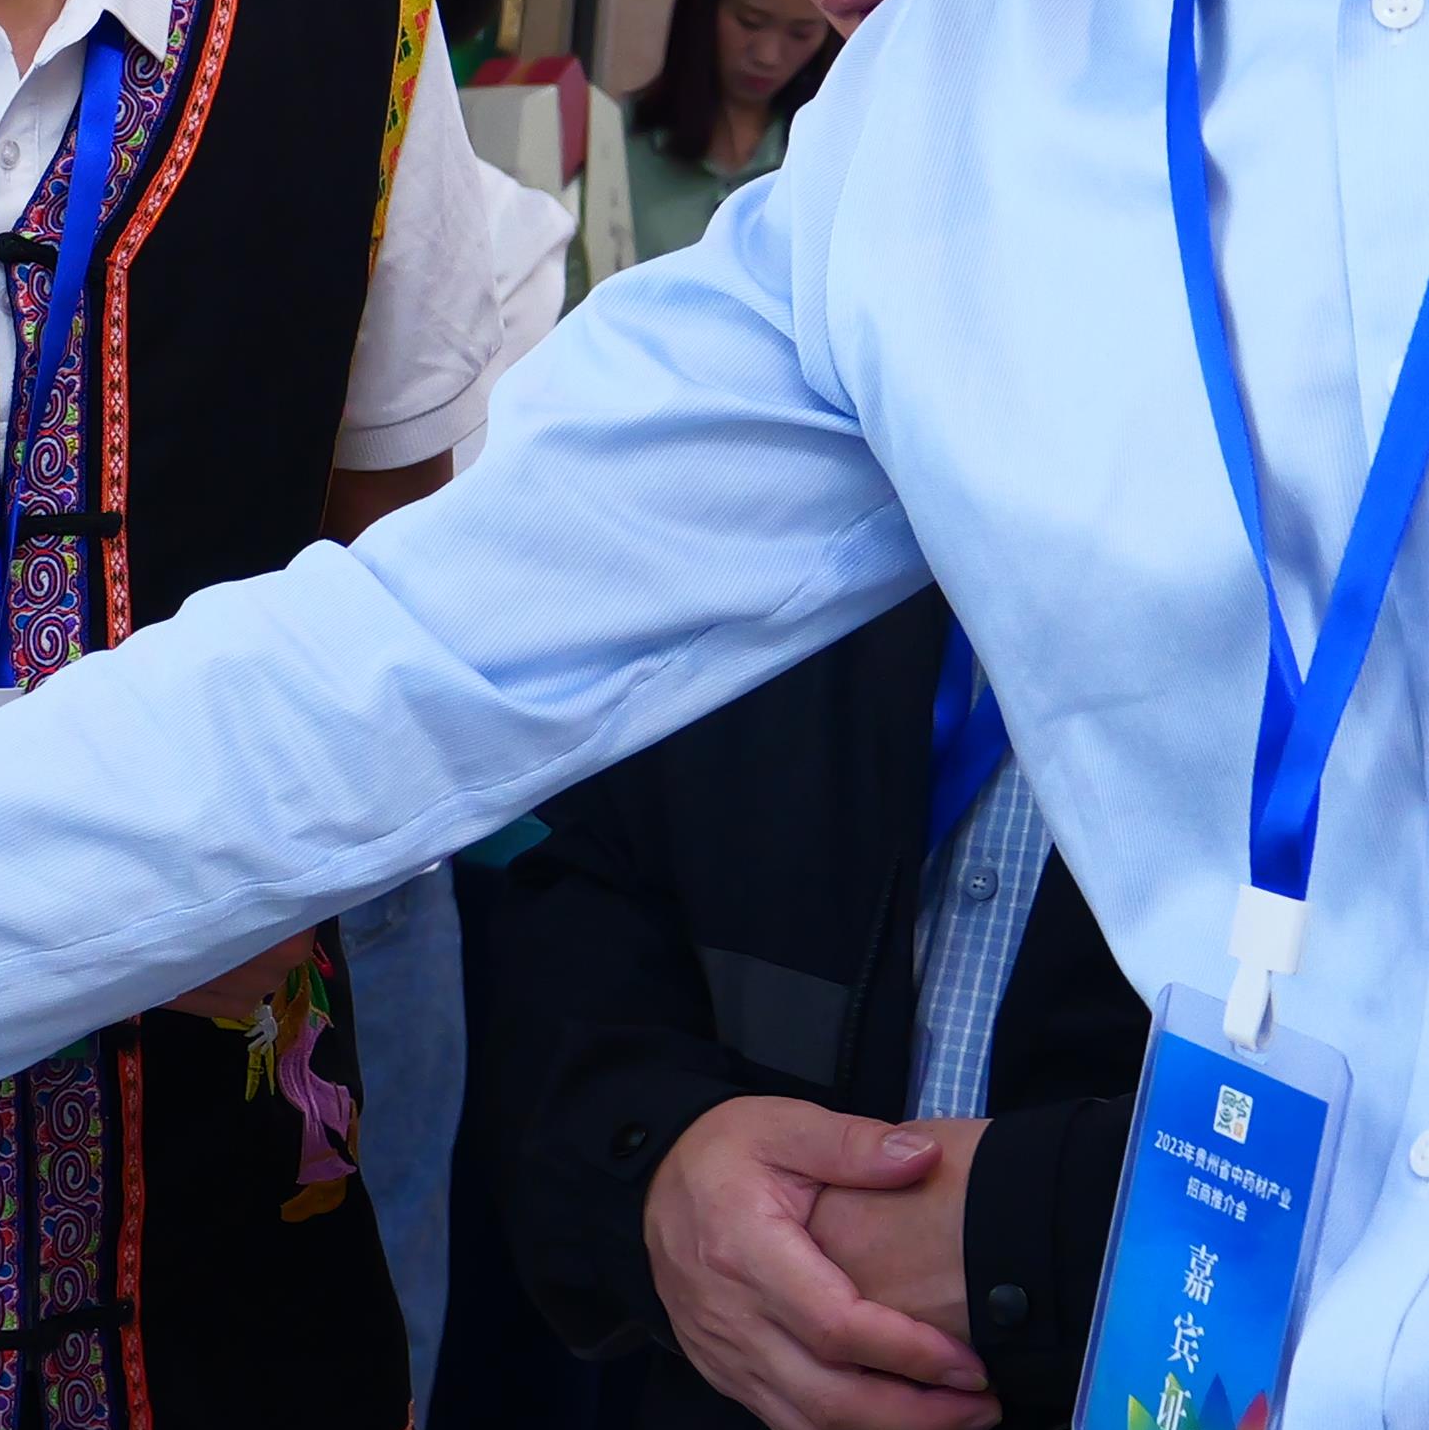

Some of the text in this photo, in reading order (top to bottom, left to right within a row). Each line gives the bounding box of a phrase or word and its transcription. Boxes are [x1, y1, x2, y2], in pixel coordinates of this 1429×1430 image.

[1186, 1175, 1248, 1223] 招商推介会
